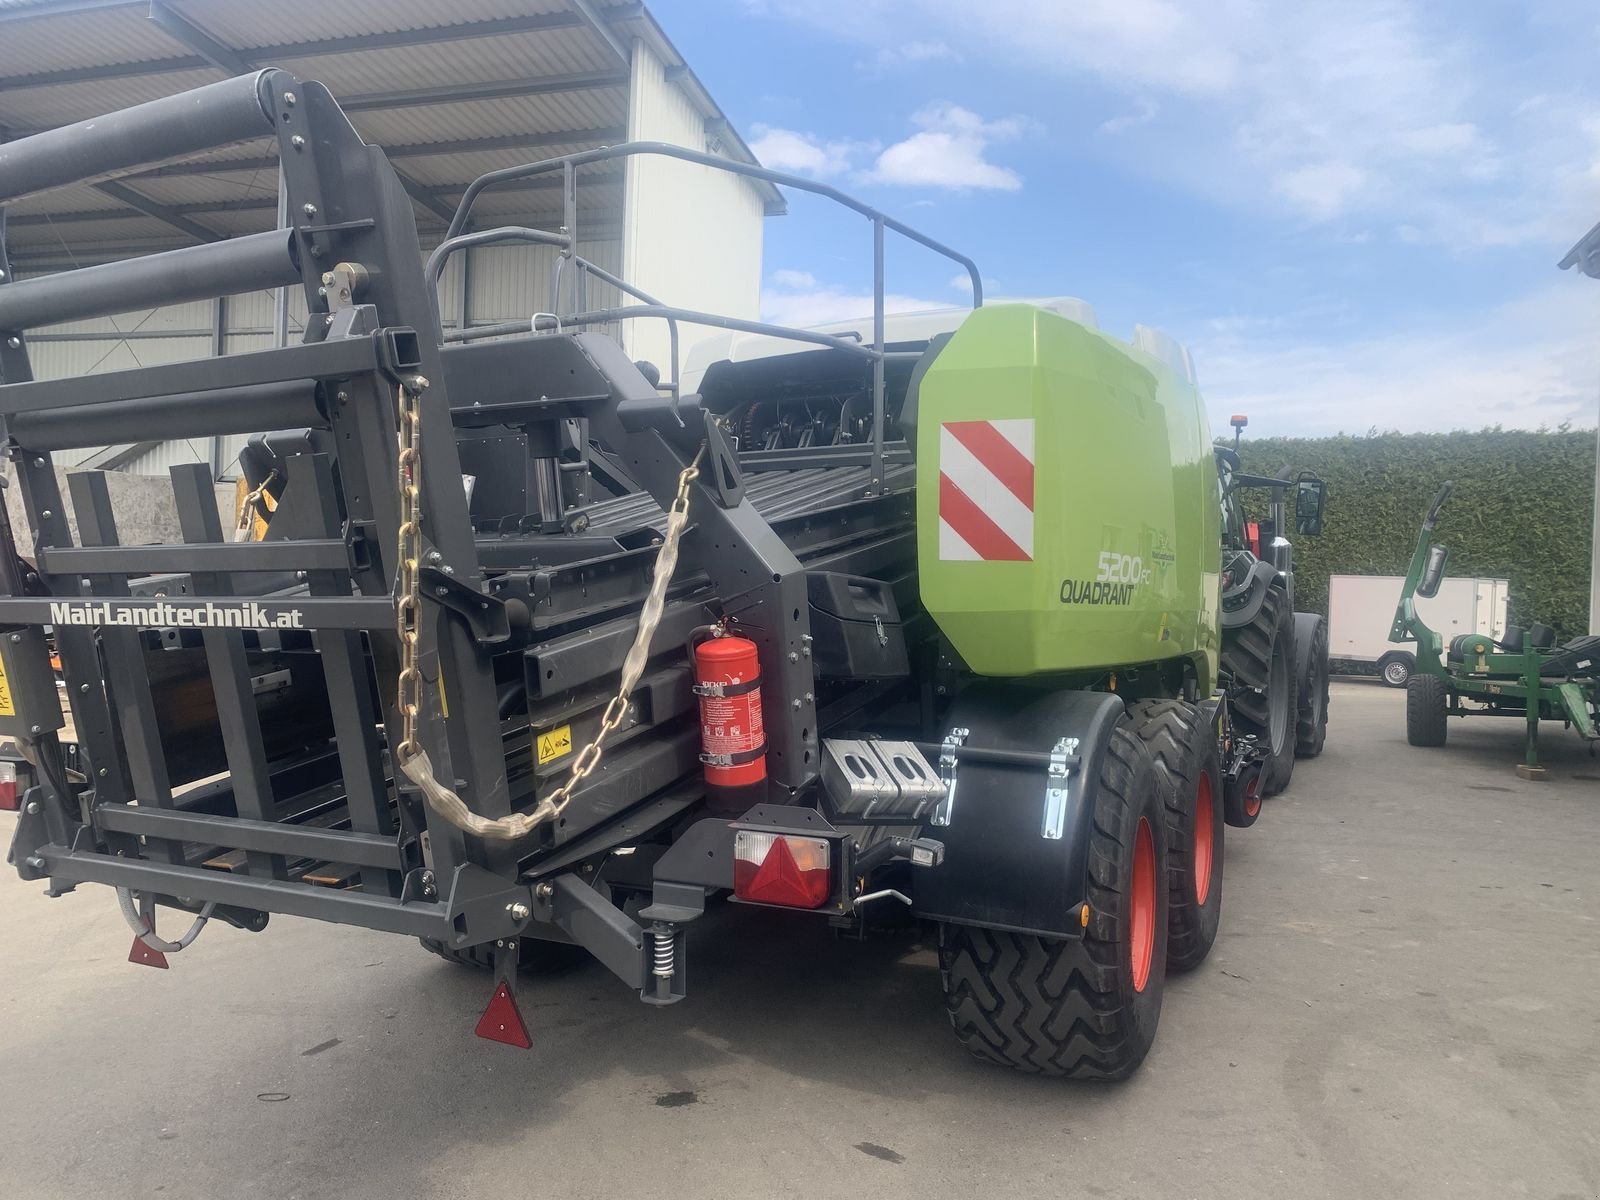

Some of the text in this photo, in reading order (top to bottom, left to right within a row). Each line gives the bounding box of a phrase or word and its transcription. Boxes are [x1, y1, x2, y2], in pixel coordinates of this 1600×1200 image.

[1097, 551, 1142, 583] 5200
[1060, 579, 1134, 604] QUADRANT
[50, 602, 303, 628] MairLandtechnik.at
